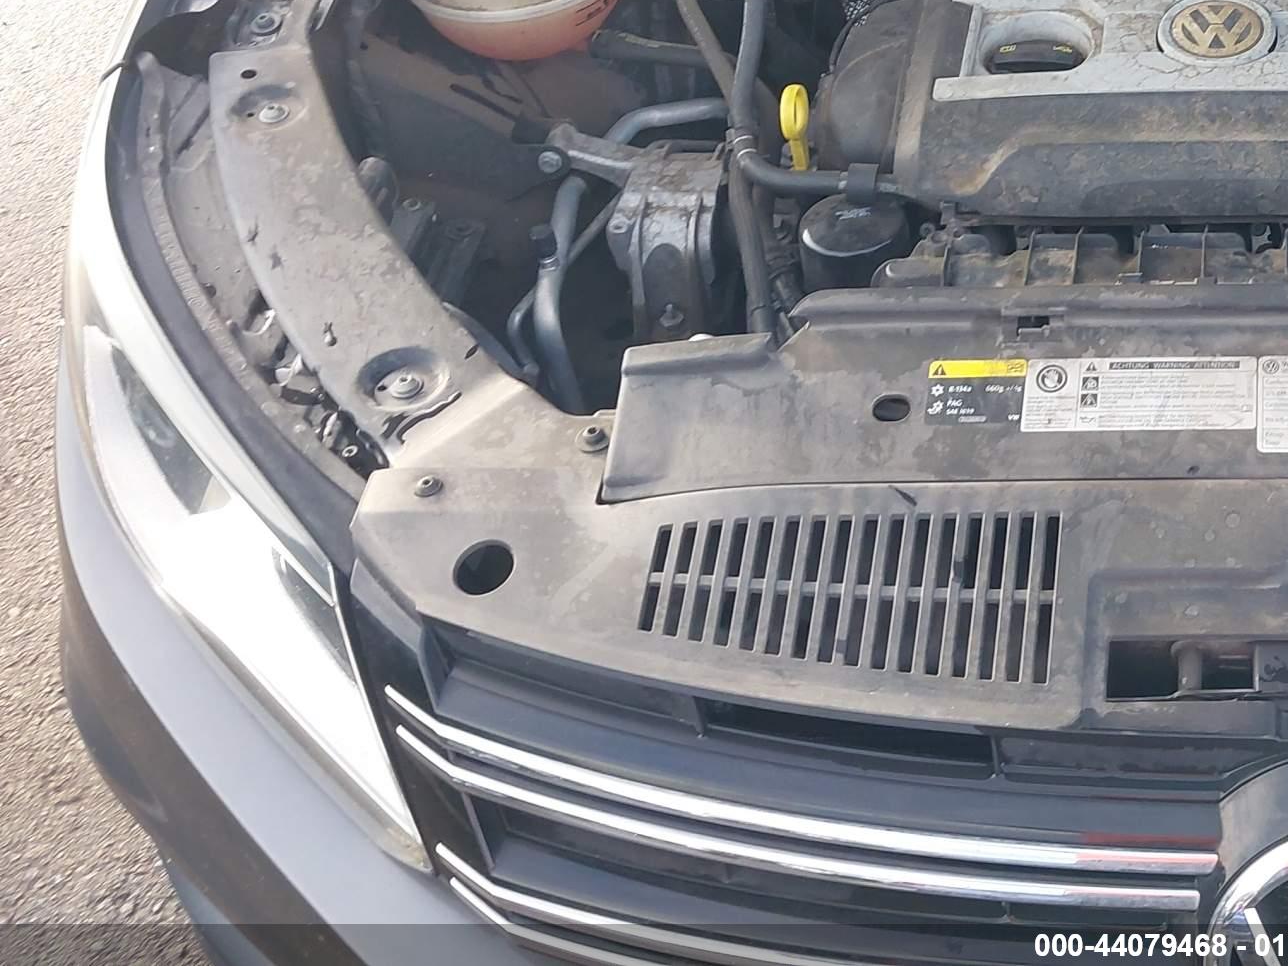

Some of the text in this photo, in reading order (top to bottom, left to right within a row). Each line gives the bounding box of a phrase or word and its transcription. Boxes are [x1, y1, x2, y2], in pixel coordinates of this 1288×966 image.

[1173, 0, 1265, 60] VW
[1112, 362, 1150, 370] ACHTUNG
[1193, 361, 1236, 369] ATTENTION
